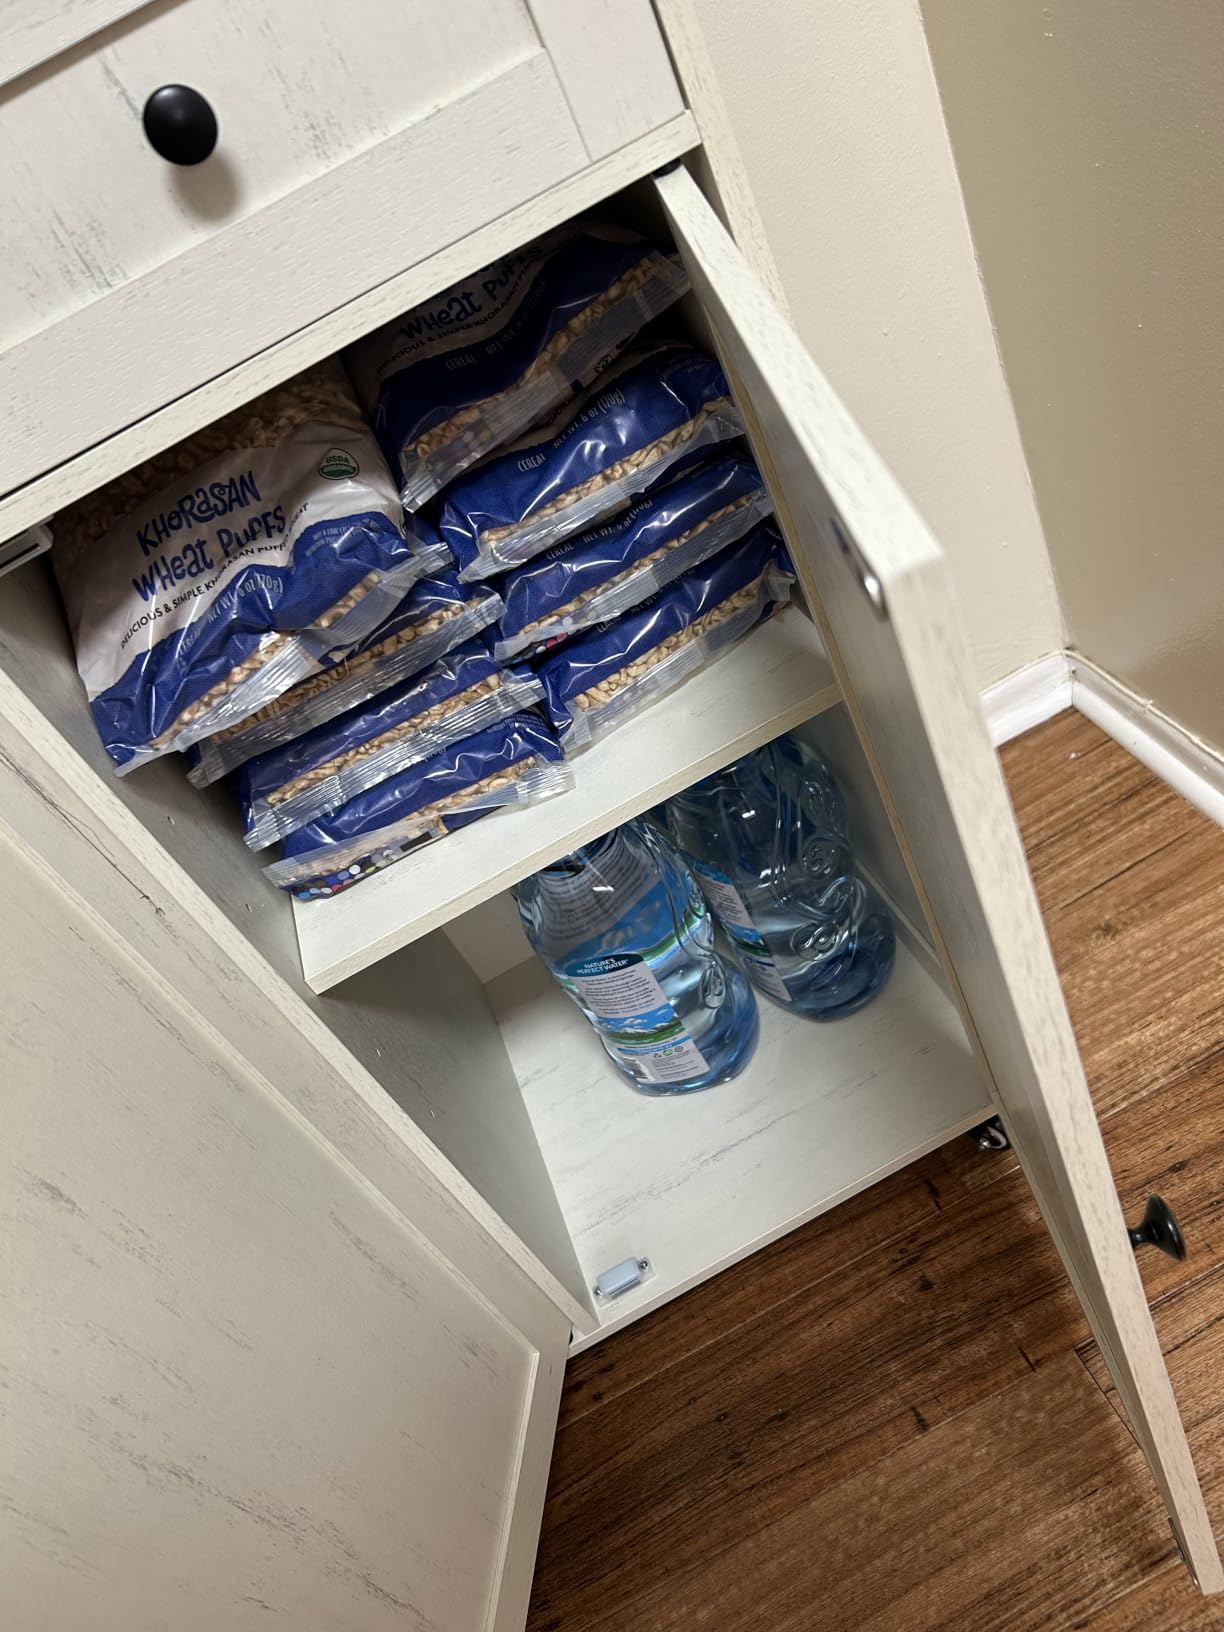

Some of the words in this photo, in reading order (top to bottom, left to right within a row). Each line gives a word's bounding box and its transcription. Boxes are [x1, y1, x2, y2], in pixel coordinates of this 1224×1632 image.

[597, 388, 625, 414] (170g)
[326, 455, 350, 464] USDA
[518, 453, 546, 472] CEREAL
[546, 542, 575, 560] CEREAL
[120, 607, 163, 649] DELICIOUS
[164, 603, 173, 613] &
[172, 585, 204, 608] SIMPLE
[205, 547, 256, 593] KHRASAN
[577, 966, 603, 975] PERFECT
[584, 958, 616, 969] NATURE'S
